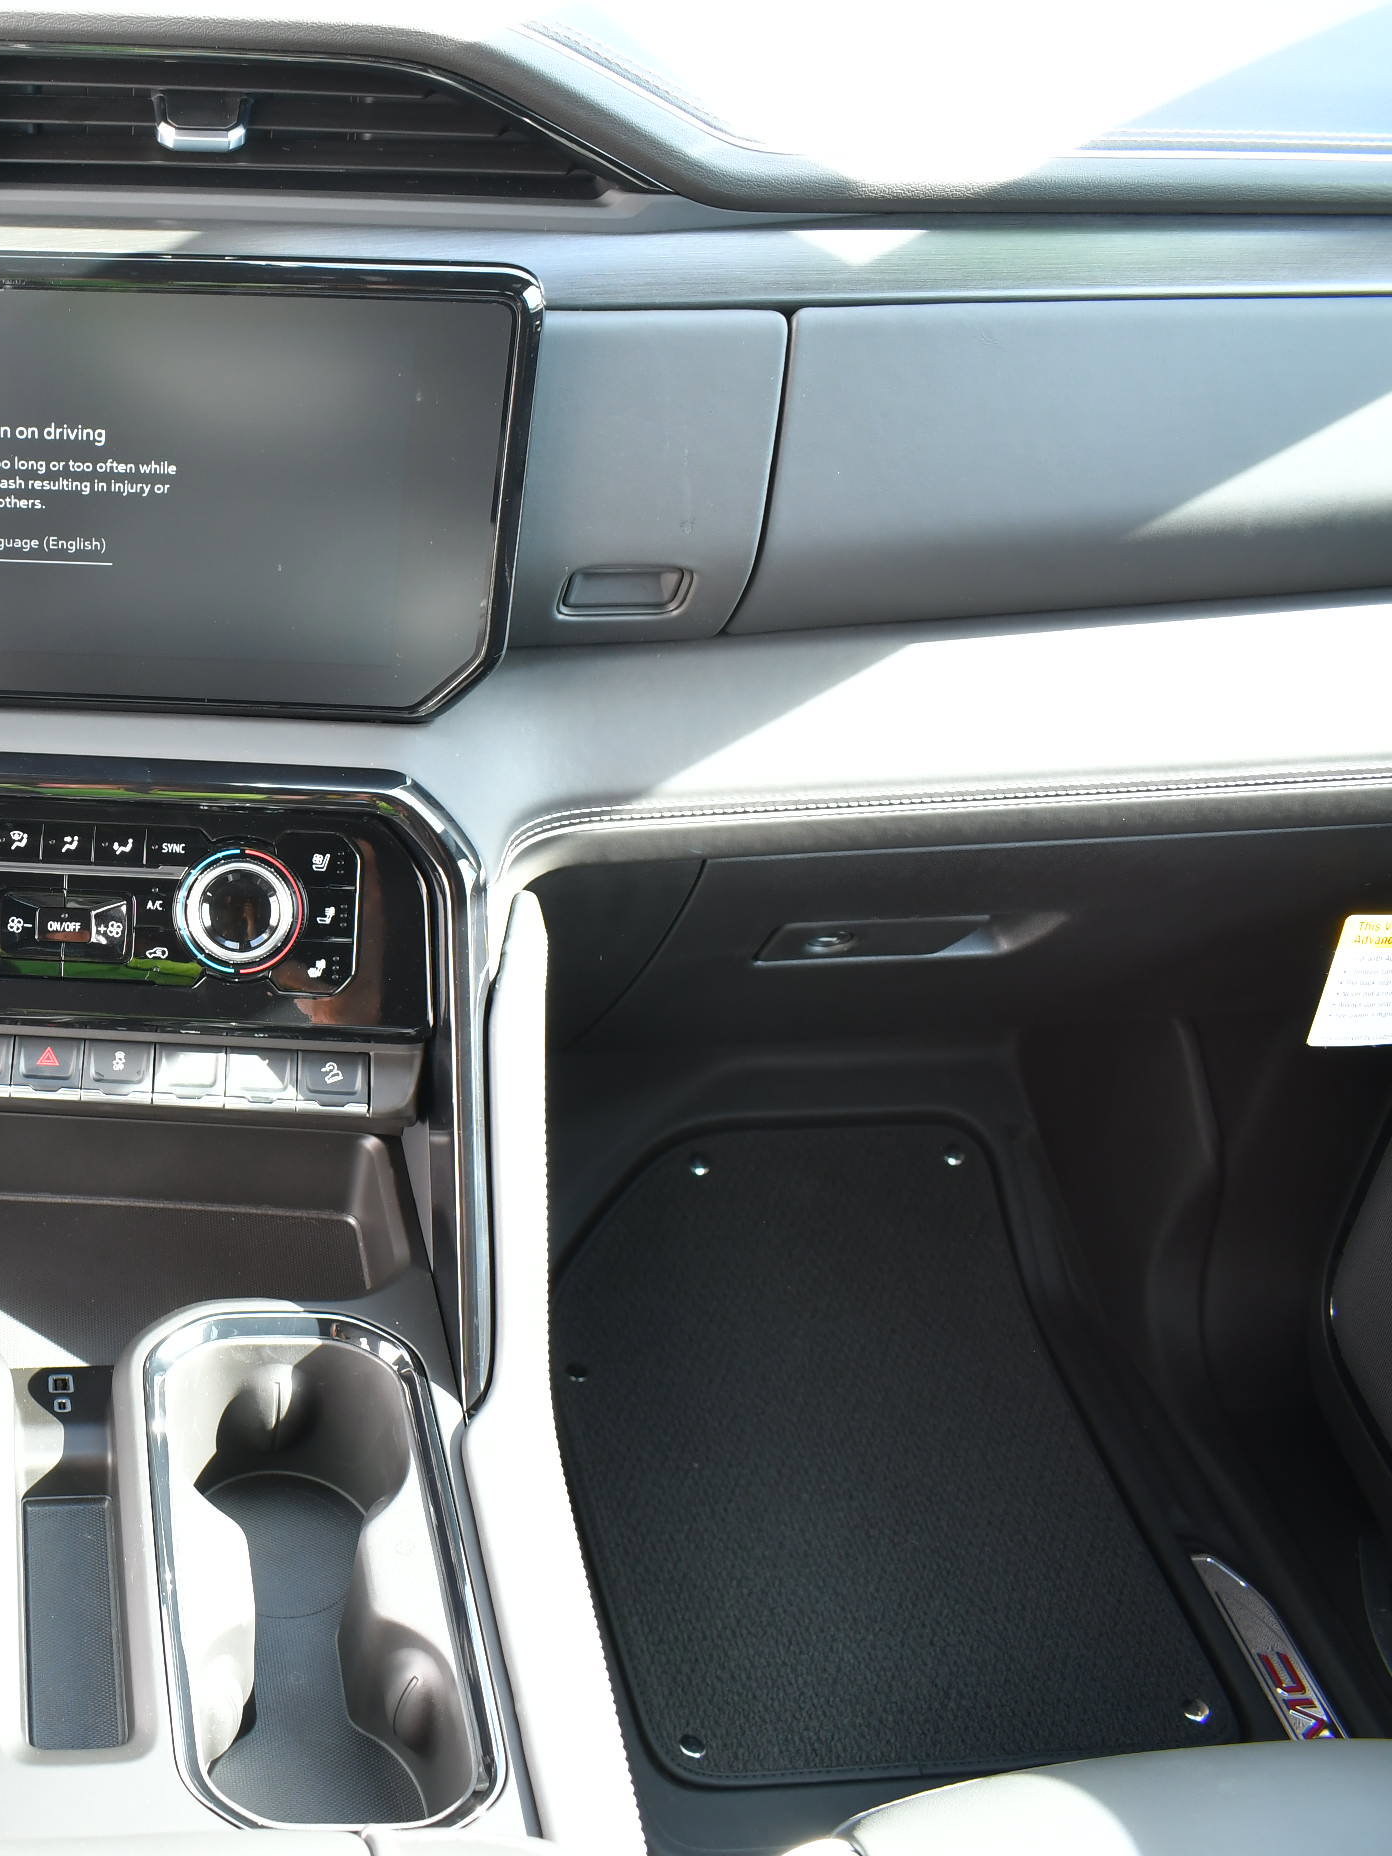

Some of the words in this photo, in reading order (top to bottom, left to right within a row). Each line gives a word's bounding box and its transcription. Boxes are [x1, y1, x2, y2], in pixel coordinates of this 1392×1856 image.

[16, 426, 39, 439] on
[44, 422, 106, 446] driving
[15, 456, 46, 474] long
[49, 460, 65, 471] or
[69, 459, 93, 472] too
[96, 459, 135, 474] often
[139, 461, 177, 475] while
[28, 477, 90, 495] resulting
[95, 480, 107, 492] in
[111, 480, 151, 496] injury
[154, 483, 170, 494] or
[43, 536, 106, 553] (English)
[161, 843, 186, 854] SYNC
[146, 900, 163, 910] A/C
[47, 921, 81, 932] ON/OFF
